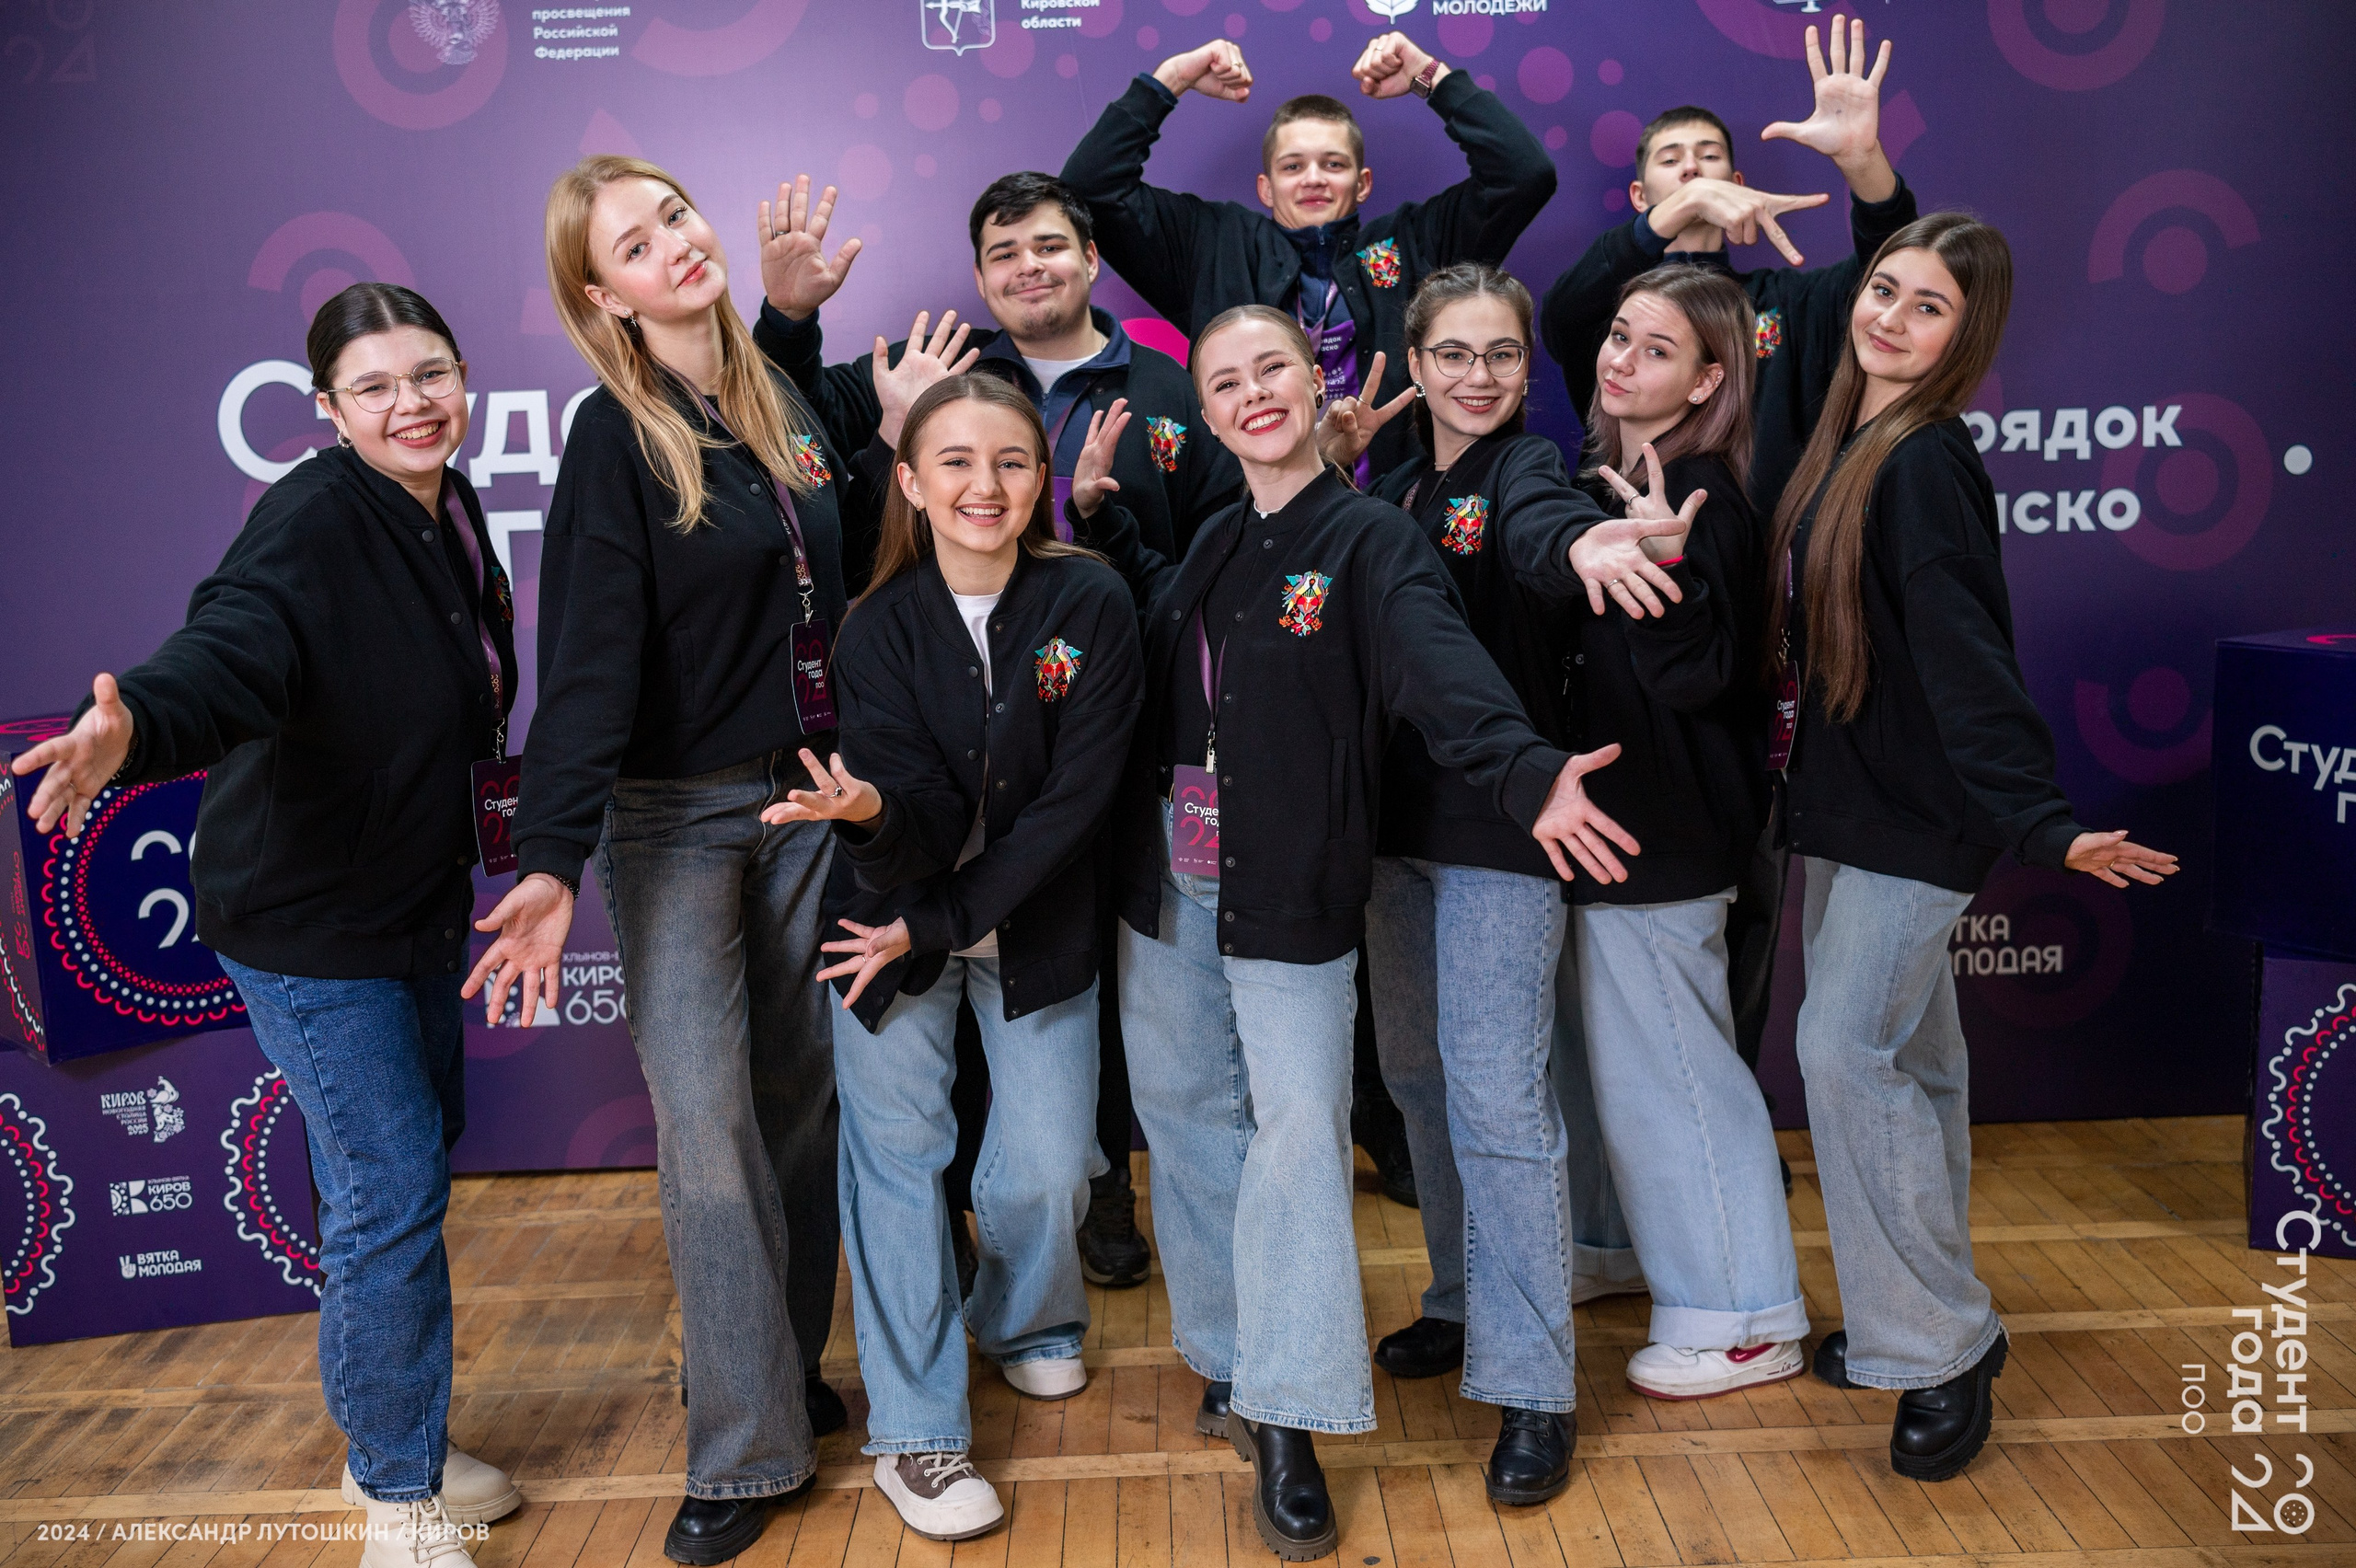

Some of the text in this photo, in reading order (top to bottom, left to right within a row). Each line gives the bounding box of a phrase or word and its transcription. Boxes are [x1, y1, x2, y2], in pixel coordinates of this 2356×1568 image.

[531, 6, 631, 23] просвещения
[1432, 0, 1548, 16] МОЛОДЕЖИ
[1021, 16, 1082, 29] области
[533, 23, 618, 40] Российской
[534, 46, 620, 61] Федерации
[1959, 405, 2182, 460] рядок
[1994, 489, 2141, 534] ско
[2249, 724, 2356, 791] Студ
[484, 796, 519, 813] Студен
[1184, 802, 1219, 818] Студе
[1955, 914, 2010, 943] ТКА
[100, 1090, 146, 1109] КИРОВ
[148, 1182, 191, 1195] КИРОВ
[149, 1192, 193, 1212] 650
[136, 1250, 179, 1265] ВЯТКА
